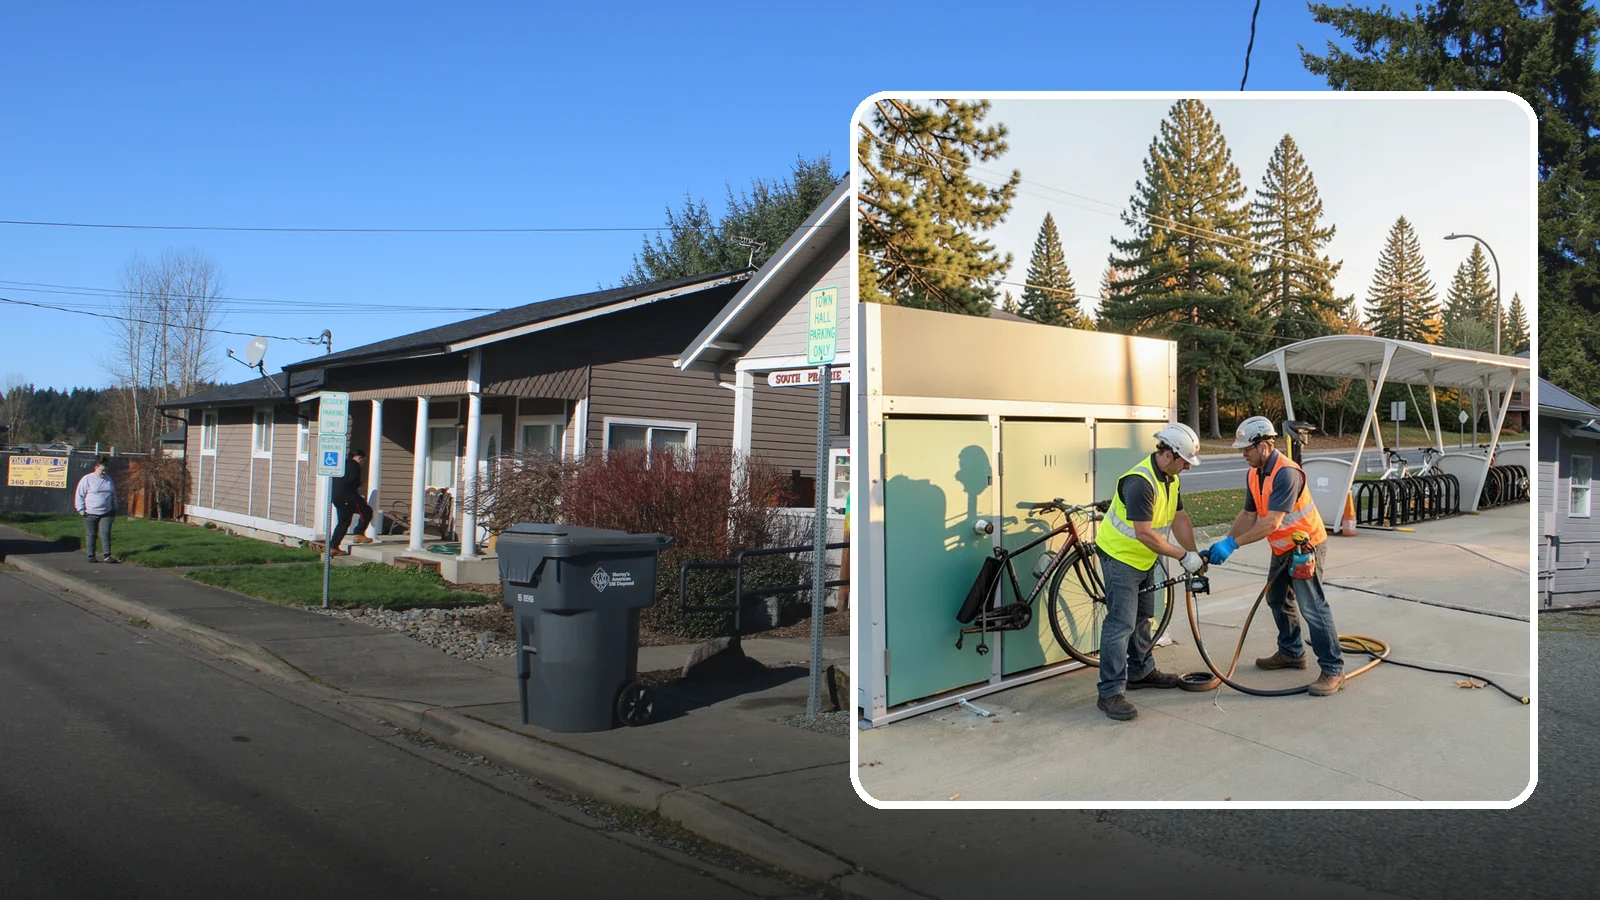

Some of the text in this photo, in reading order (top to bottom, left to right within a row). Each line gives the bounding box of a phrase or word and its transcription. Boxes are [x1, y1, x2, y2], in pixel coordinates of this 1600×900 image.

[815, 294, 832, 307] TOWN
[815, 311, 831, 324] HALL
[810, 327, 835, 340] PARKING
[813, 344, 831, 357] ONLY
[775, 373, 800, 383] SOUTH
[808, 371, 841, 382] PRIE
[11, 457, 26, 465] COAST
[10, 479, 65, 487] 360-897-8625
